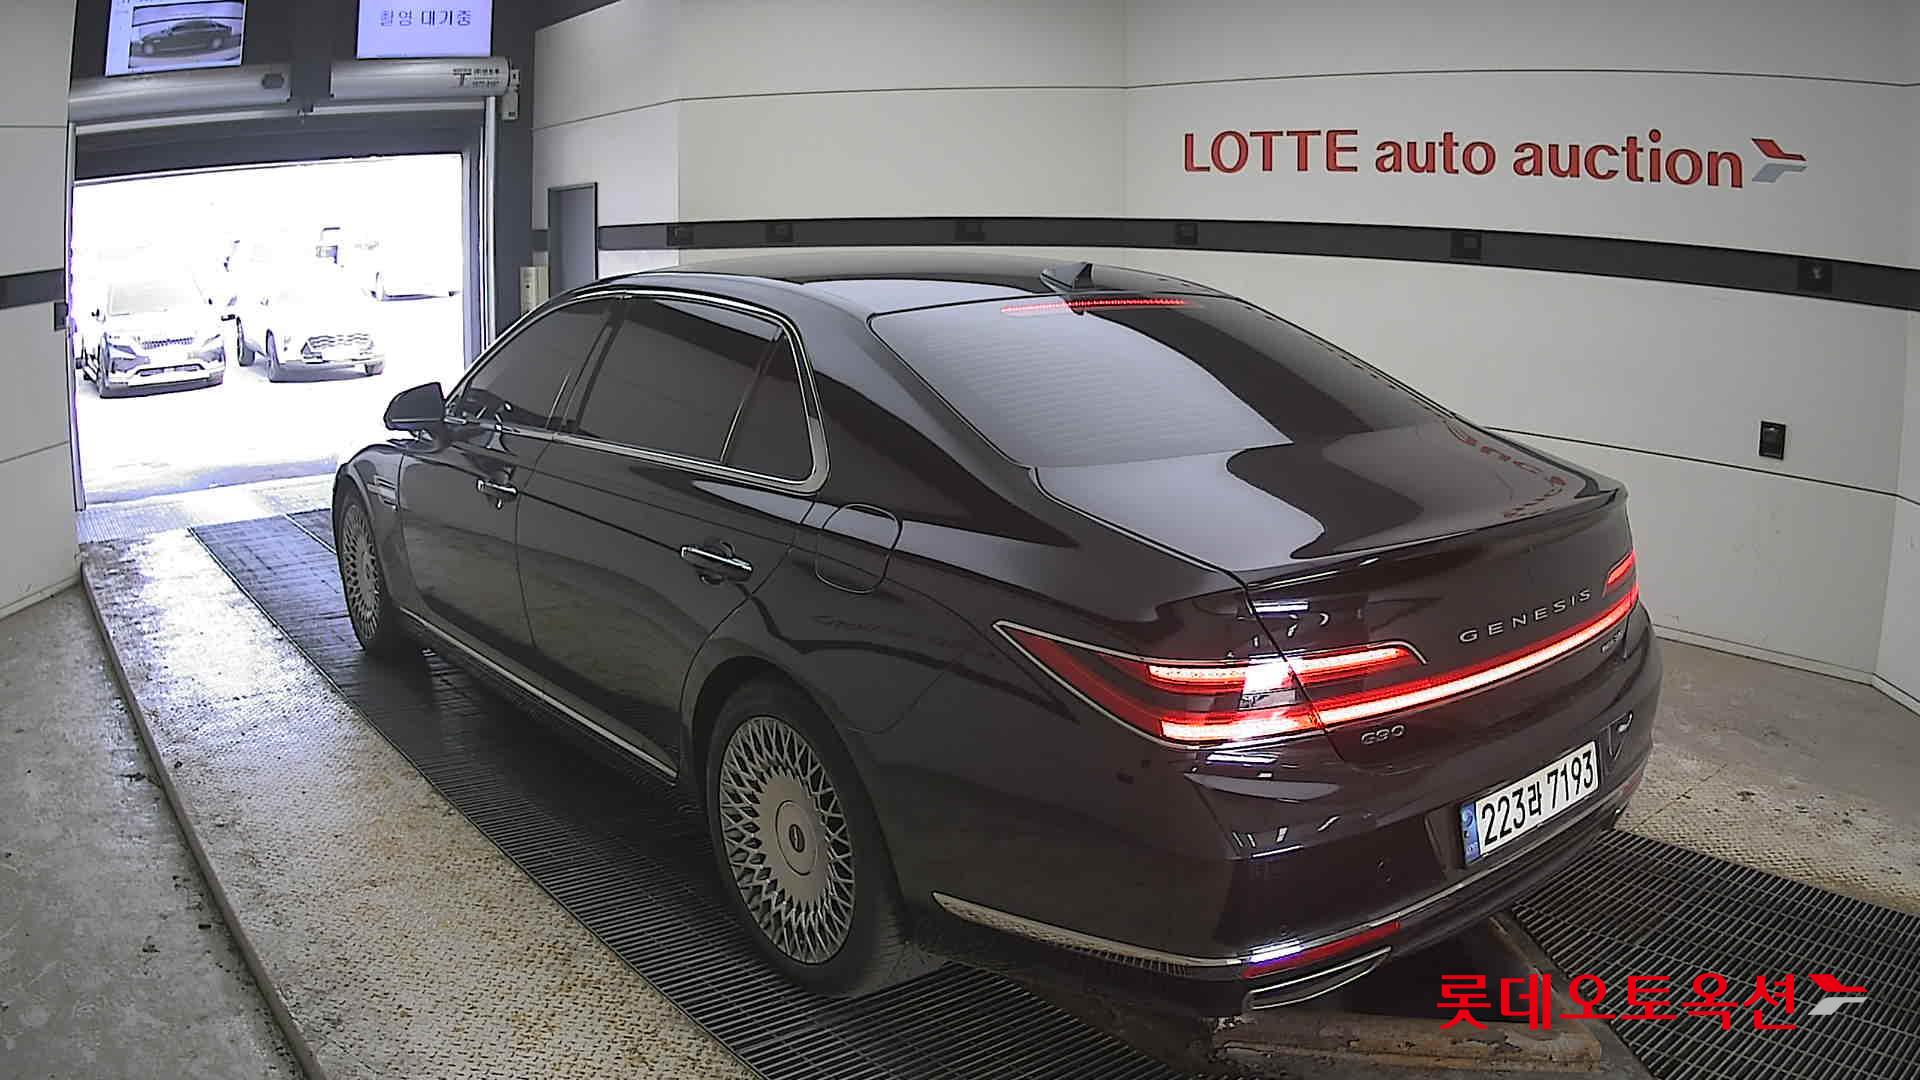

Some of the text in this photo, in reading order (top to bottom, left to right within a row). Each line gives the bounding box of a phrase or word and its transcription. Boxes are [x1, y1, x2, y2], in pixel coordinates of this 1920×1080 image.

[420, 9, 472, 27] 대기중
[1183, 128, 1744, 189] LOTTE auto auction
[1458, 588, 1592, 643] GENESIS
[1360, 724, 1405, 745] G90
[1480, 749, 1595, 847] 223라 7193
